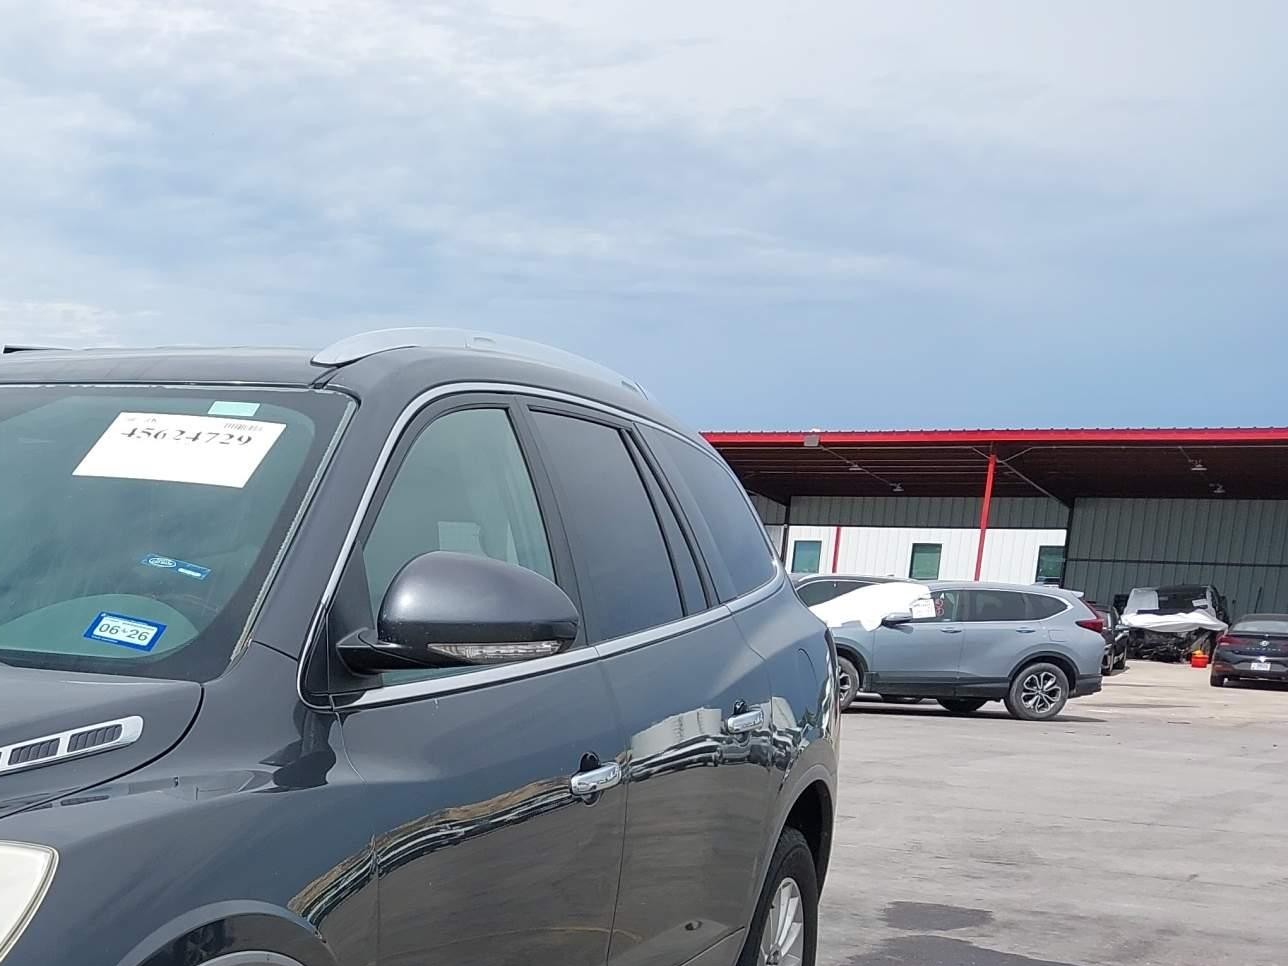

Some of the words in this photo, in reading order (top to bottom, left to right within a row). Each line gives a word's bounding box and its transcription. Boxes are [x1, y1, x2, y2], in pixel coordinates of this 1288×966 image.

[120, 427, 252, 446] 45624729
[99, 623, 120, 635] 06
[126, 629, 150, 641] 26
